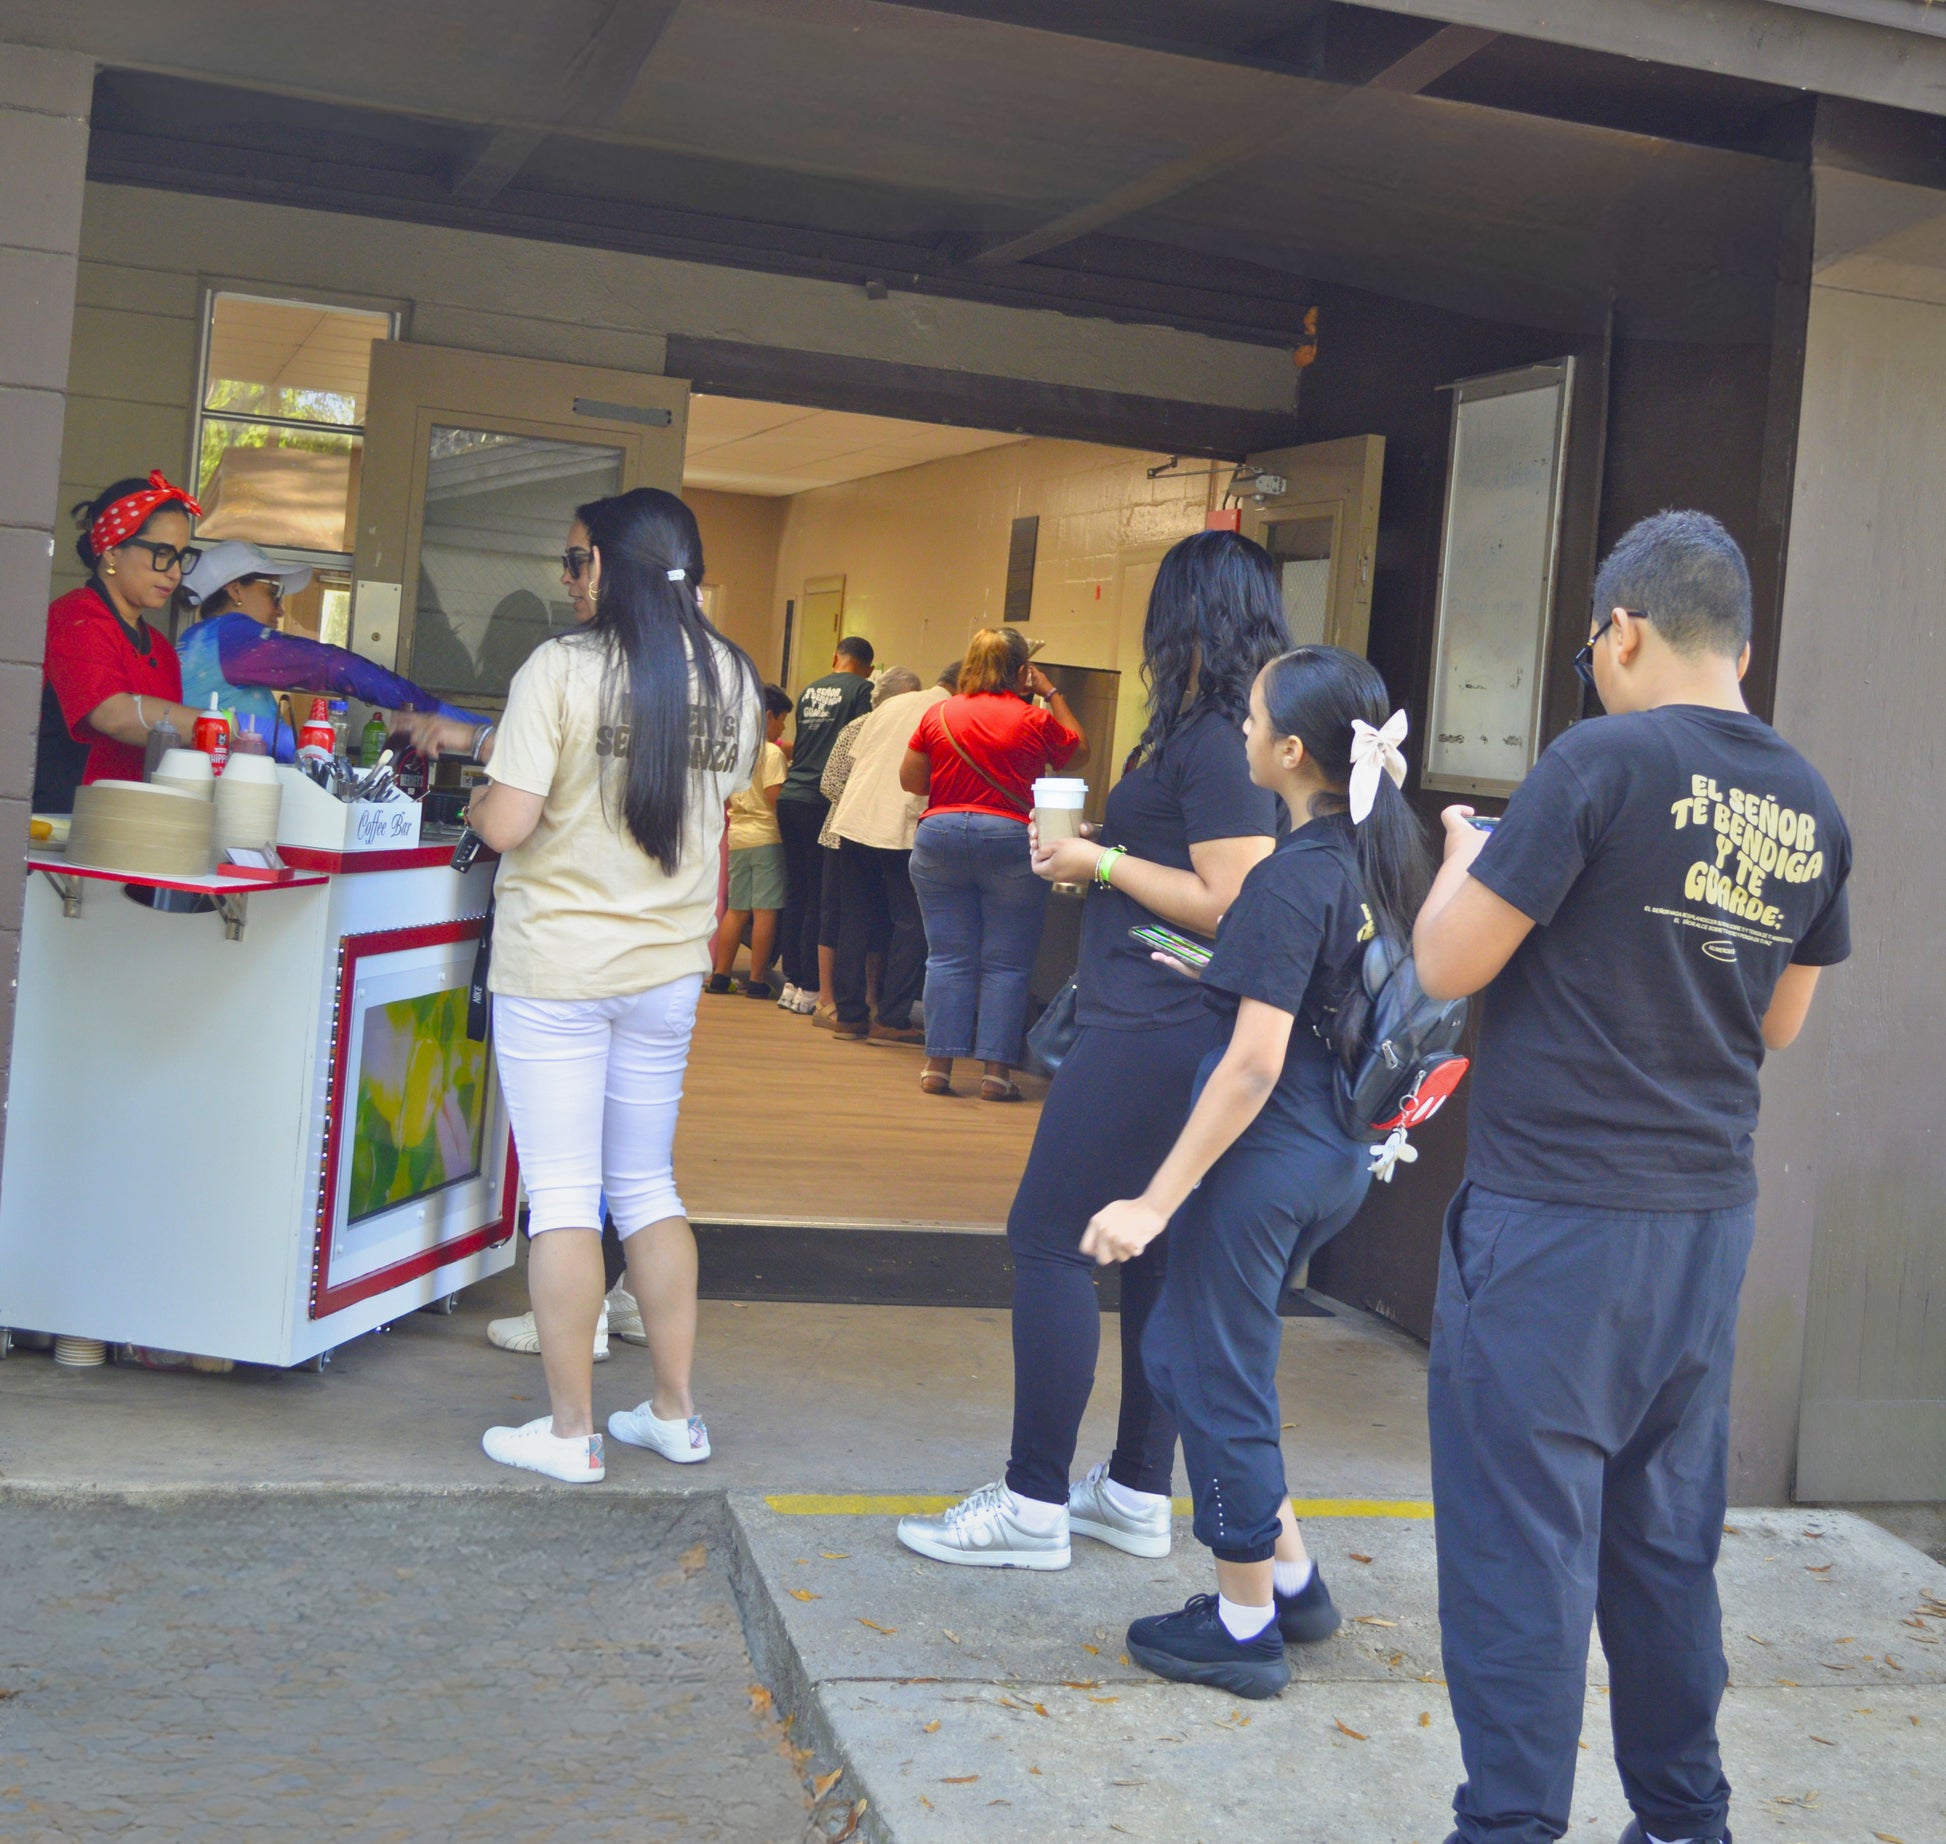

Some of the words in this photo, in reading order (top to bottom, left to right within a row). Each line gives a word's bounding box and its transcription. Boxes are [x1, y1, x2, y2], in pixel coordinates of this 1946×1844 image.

[722, 715, 736, 738] &
[357, 809, 387, 845] Coffee
[391, 811, 412, 838] Bar
[1691, 773, 1723, 802] EL
[1729, 788, 1816, 851] SEÑOR
[1671, 797, 1710, 830] TE
[1713, 802, 1823, 883] BENDIGA
[1716, 833, 1733, 869] Y
[1735, 850, 1766, 898] TE
[472, 985, 483, 1004] NIKE
